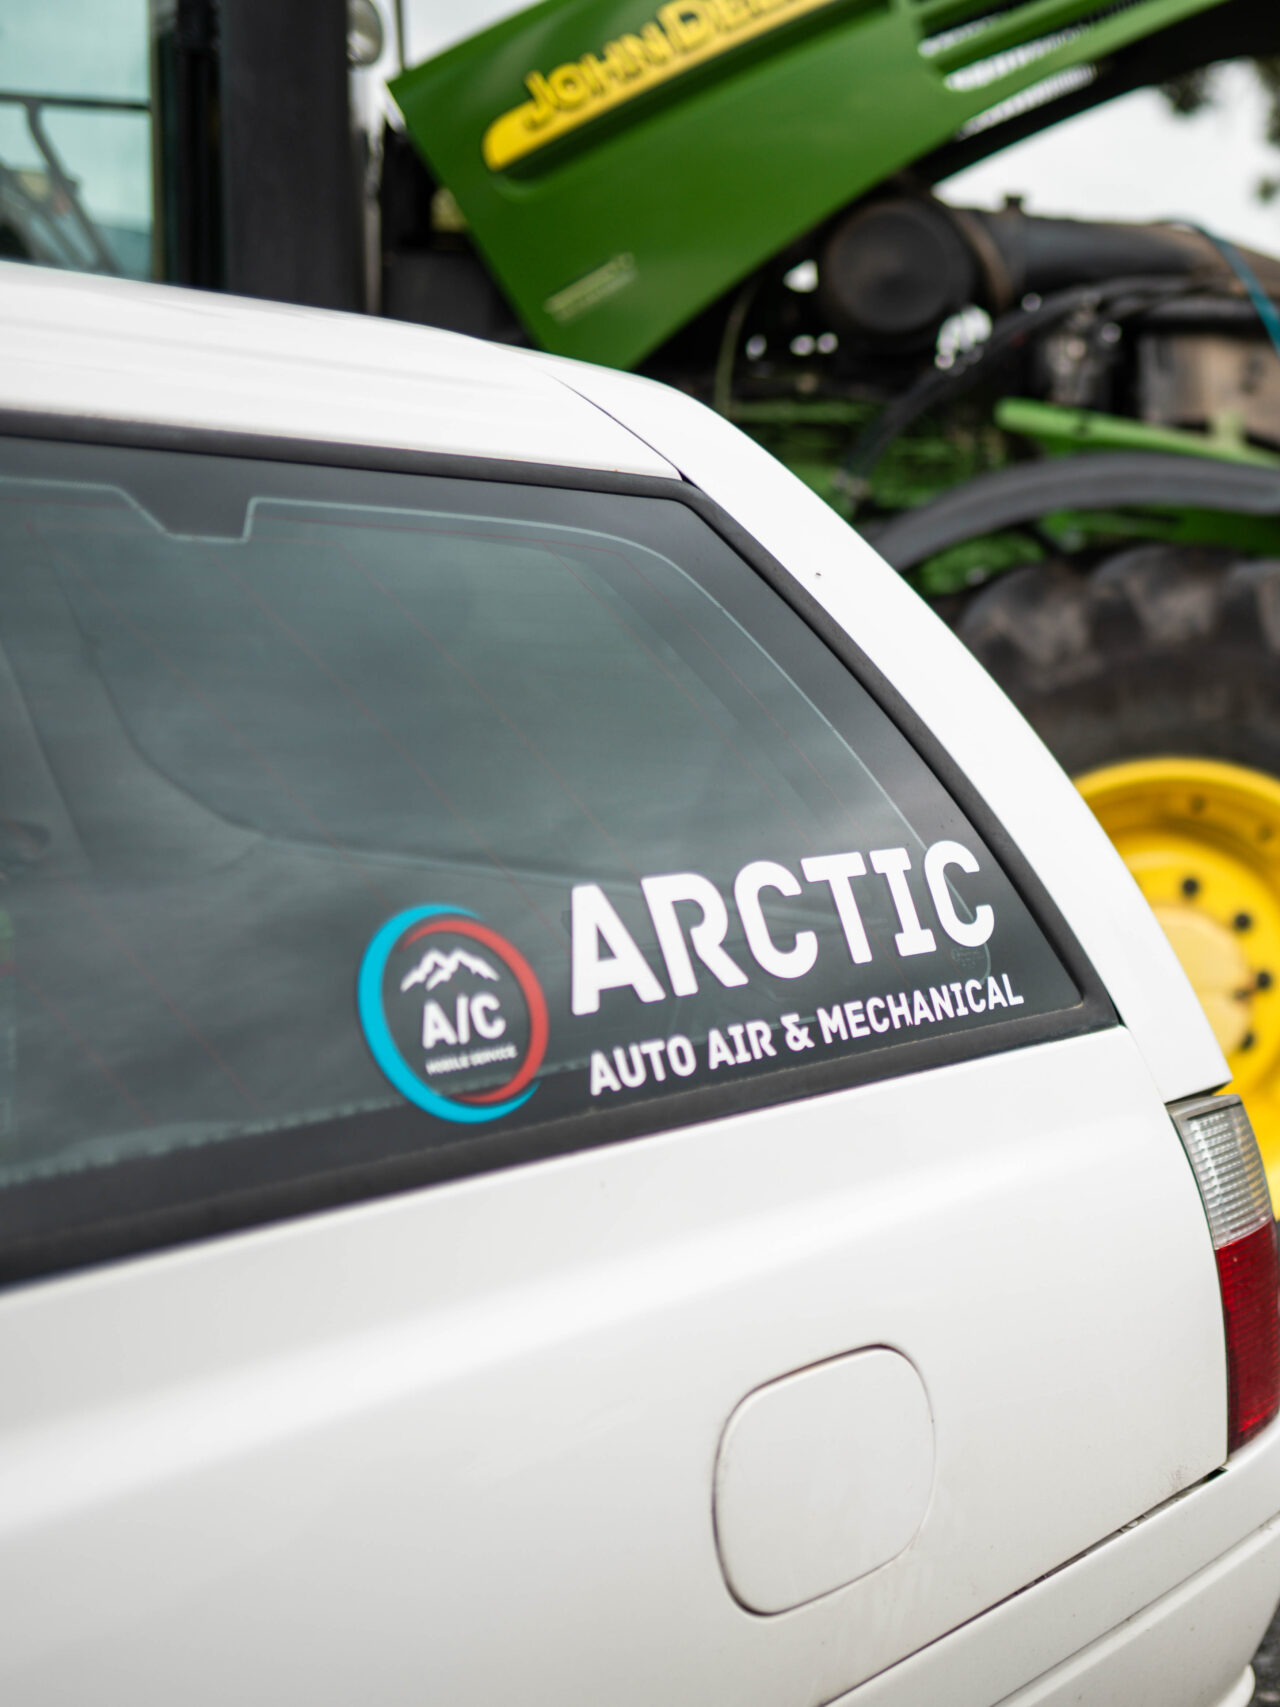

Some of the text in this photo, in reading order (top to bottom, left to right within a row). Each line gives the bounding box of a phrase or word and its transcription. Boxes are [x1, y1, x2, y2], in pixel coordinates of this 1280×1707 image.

[523, 21, 669, 132] JOHN
[571, 840, 996, 1016] ARCTIC
[422, 992, 507, 1050] A/C
[590, 973, 1025, 1096] AUTO AIR & MECHANICAL
